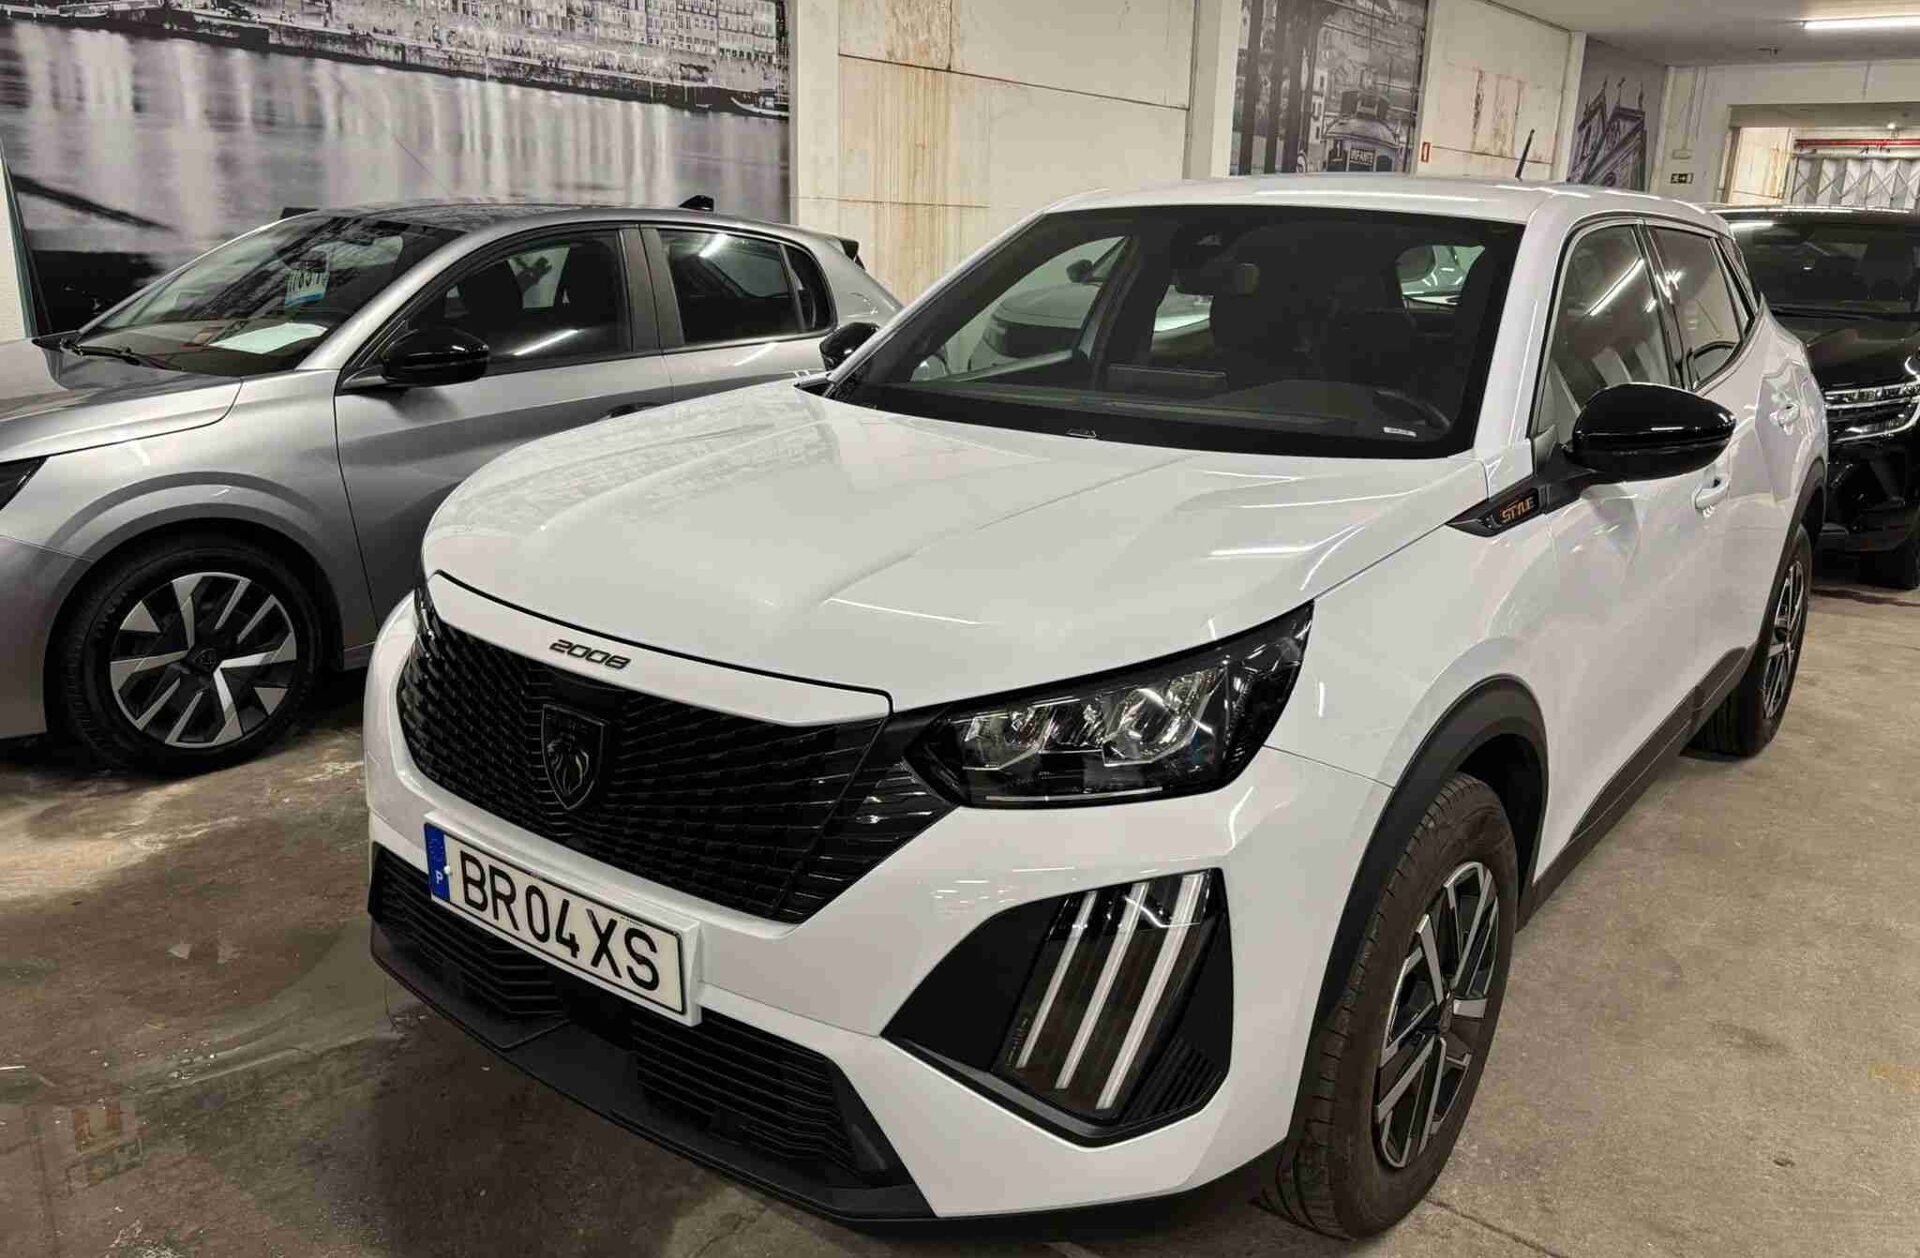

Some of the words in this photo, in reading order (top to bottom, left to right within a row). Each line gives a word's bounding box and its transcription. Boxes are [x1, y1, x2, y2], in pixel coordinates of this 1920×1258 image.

[1501, 496, 1534, 523] STYLE
[549, 639, 632, 669] 2008
[435, 870, 444, 885] P
